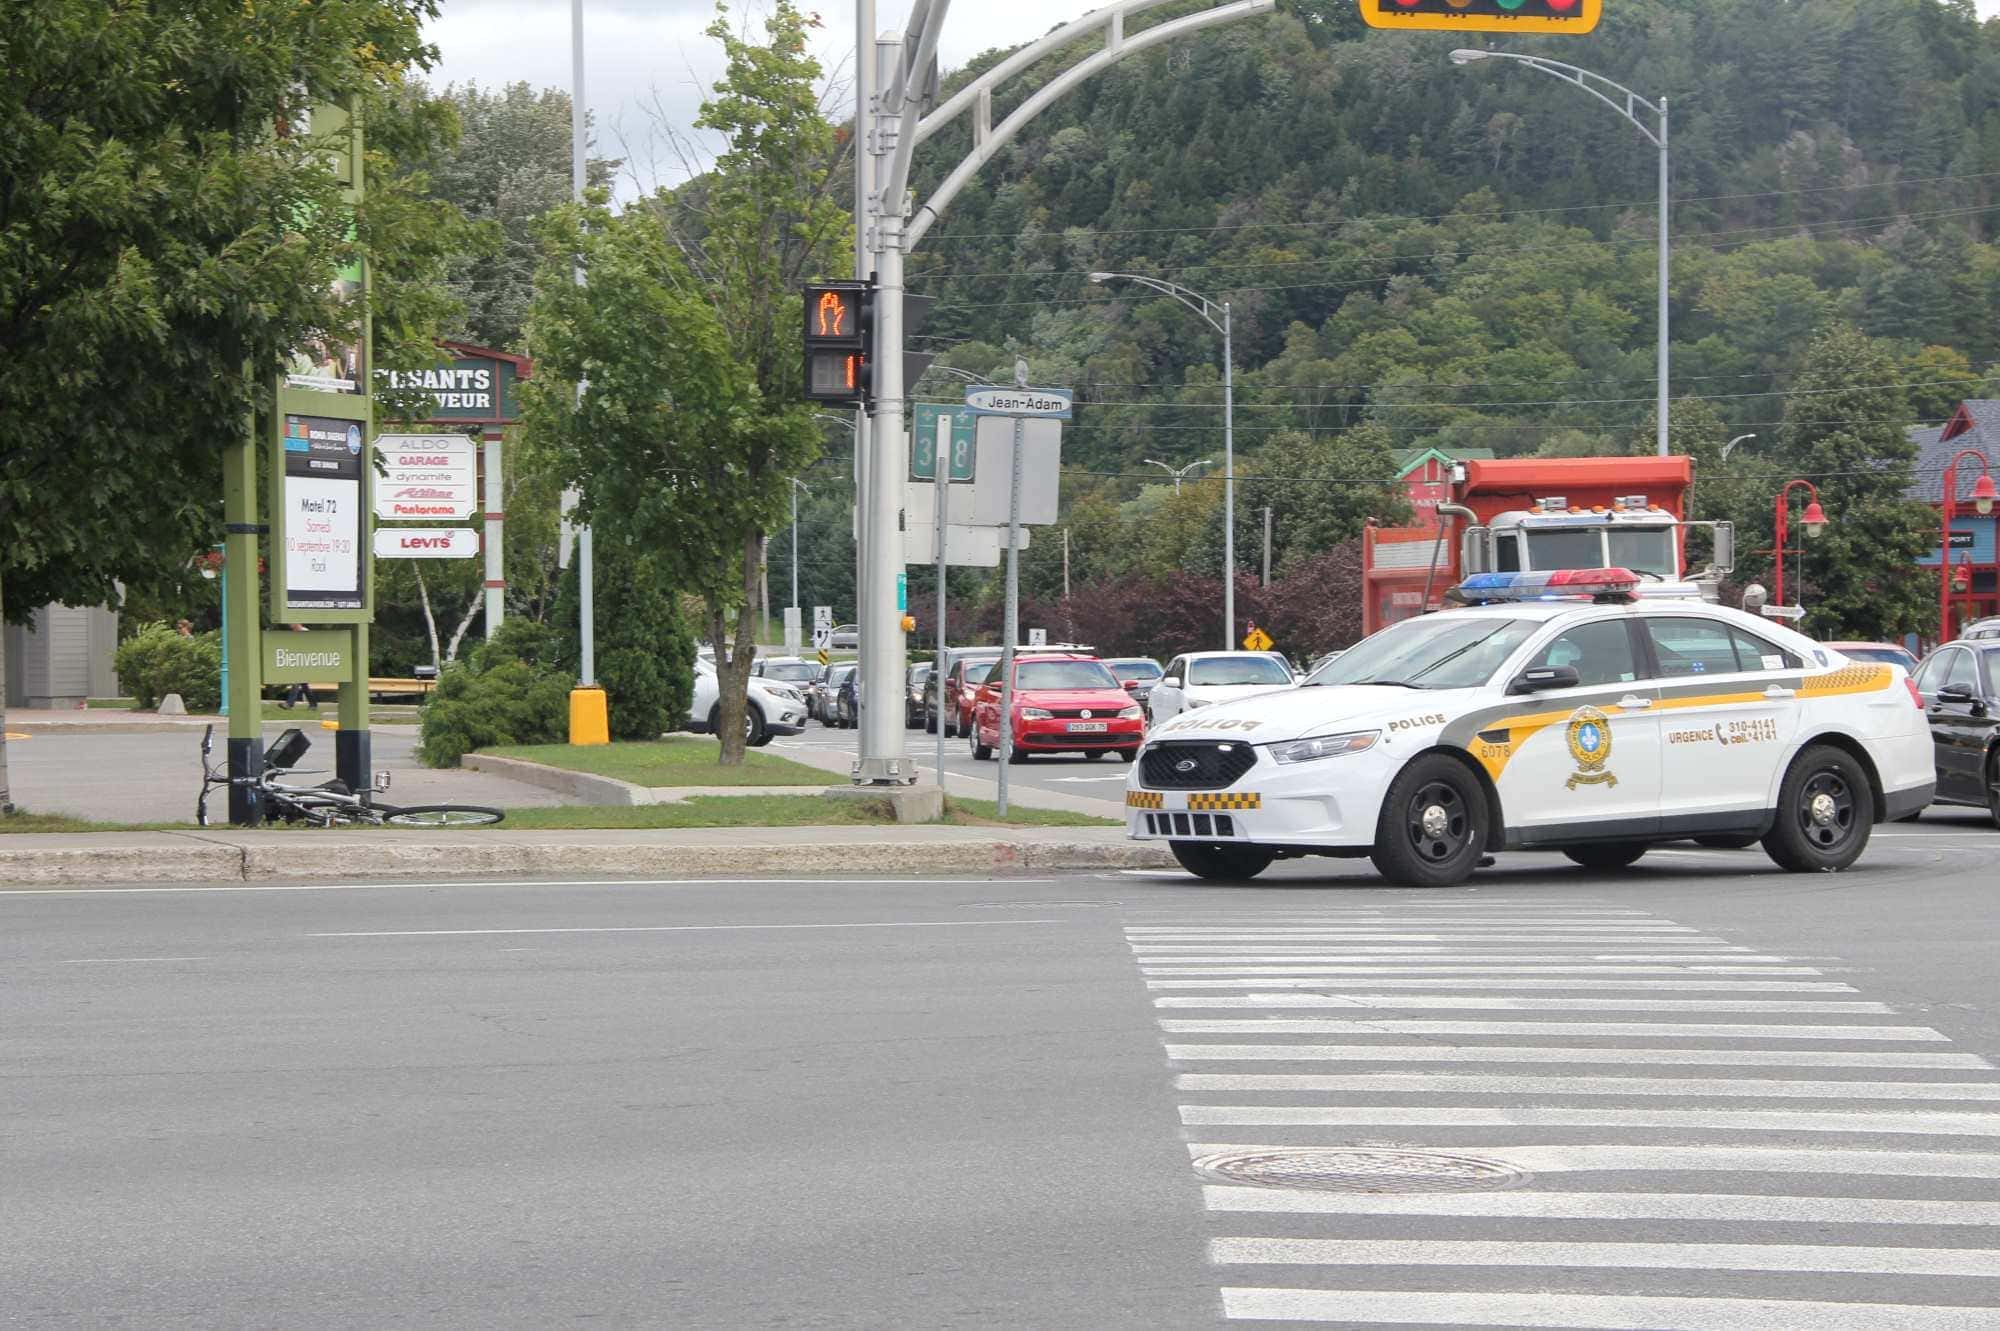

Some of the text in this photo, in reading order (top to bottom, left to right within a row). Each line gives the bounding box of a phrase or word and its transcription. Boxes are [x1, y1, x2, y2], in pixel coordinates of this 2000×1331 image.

[988, 395, 1062, 410] Jean-Adam
[399, 439, 450, 450] ALDO
[918, 436, 969, 468] 38
[399, 456, 449, 466] GARAGE
[395, 471, 453, 482] dynamite
[326, 499, 337, 514] 72
[394, 503, 455, 515] Pantorama
[275, 647, 342, 668] Bienvenue
[1388, 713, 1446, 732] POLICE
[1728, 718, 1776, 733] 310-4141
[1668, 729, 1714, 744] URGENCE
[1480, 745, 1511, 758] 6078
